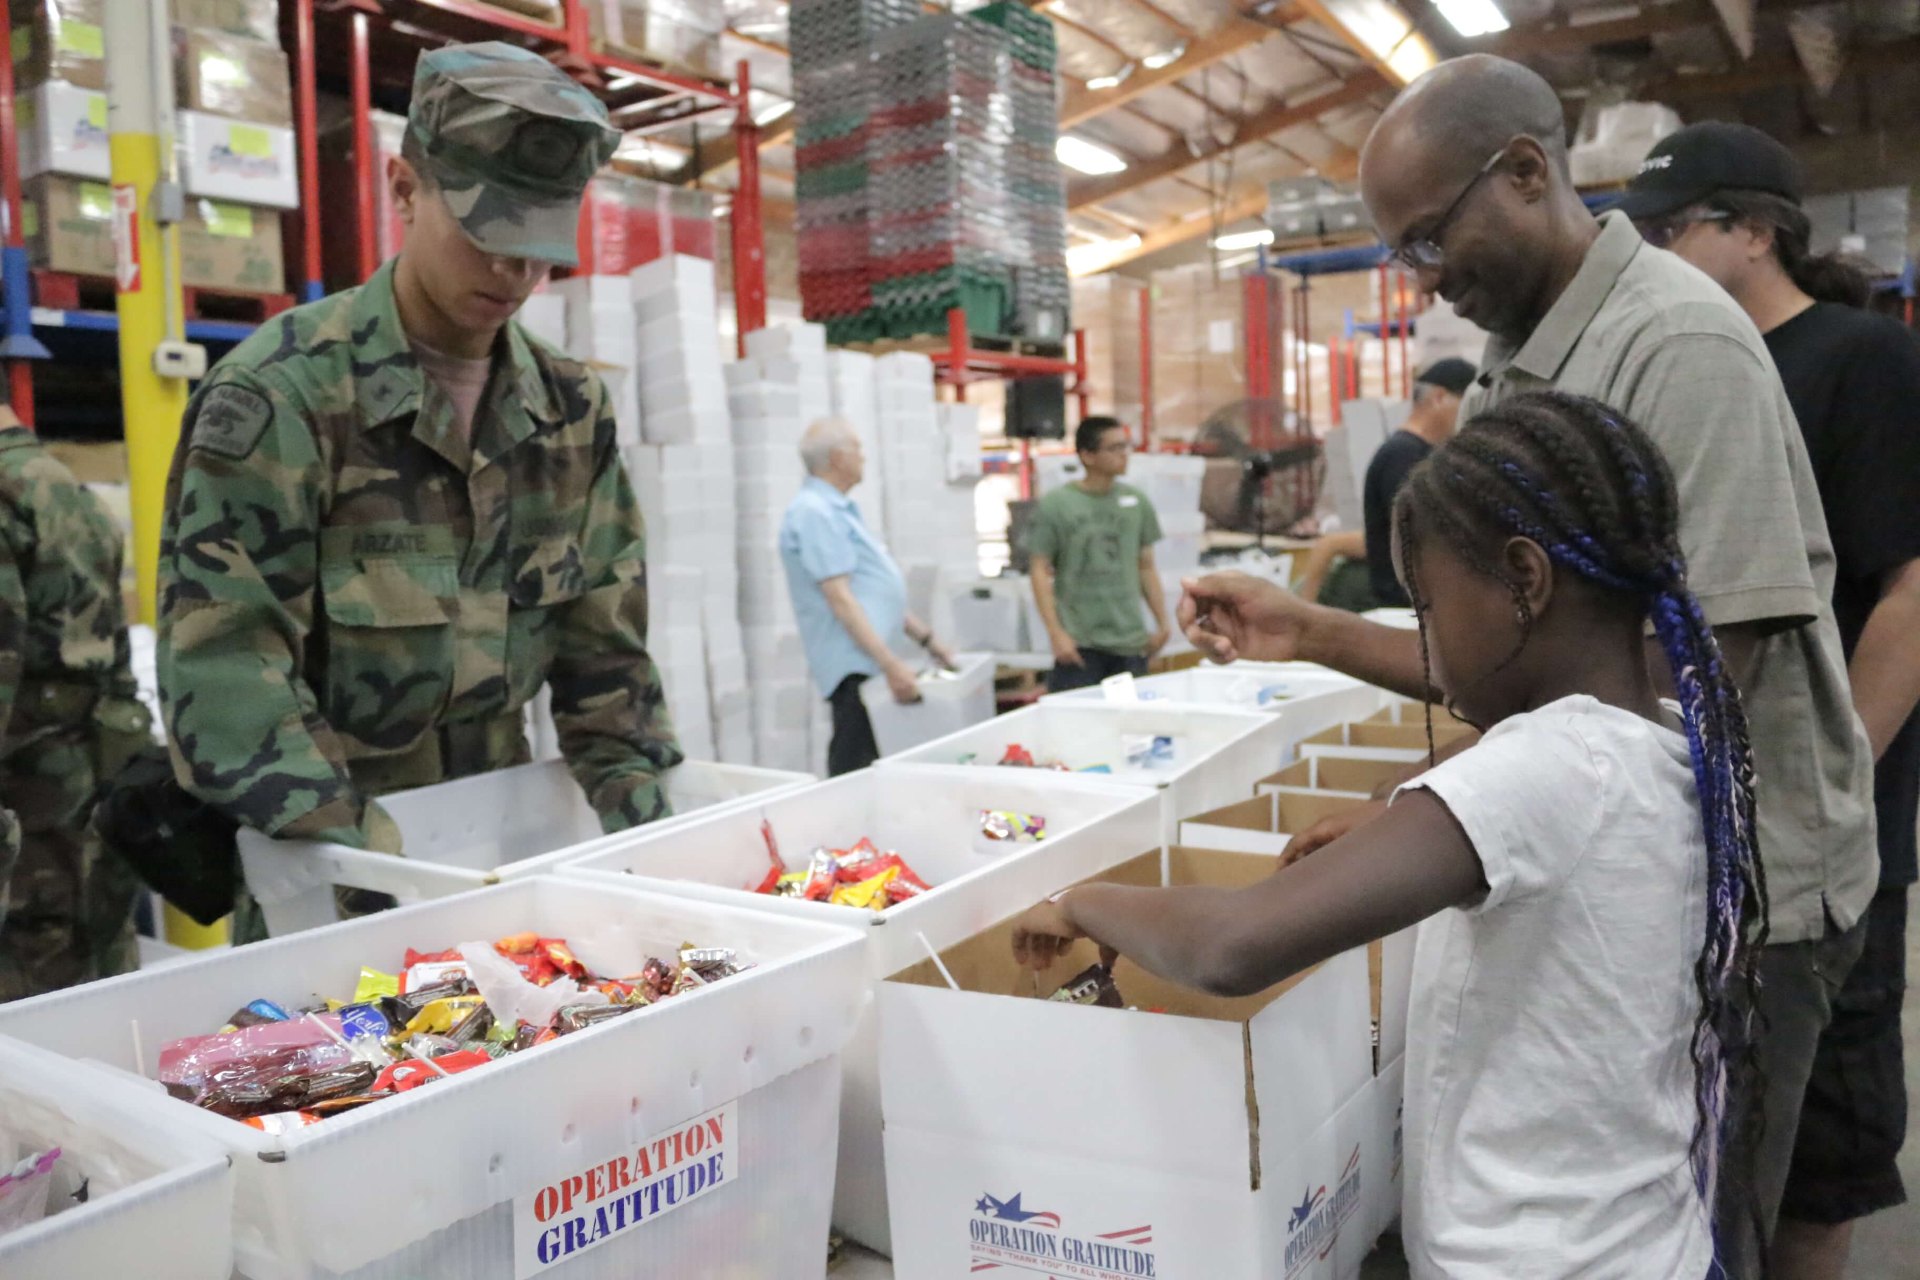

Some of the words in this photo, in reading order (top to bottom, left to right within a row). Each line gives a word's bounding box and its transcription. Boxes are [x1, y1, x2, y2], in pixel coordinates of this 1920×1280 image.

[351, 533, 427, 553] ARZATE
[341, 1008, 385, 1033] York
[533, 1113, 725, 1222] OPERATION
[537, 1152, 723, 1264] GRATITUDE
[969, 1218, 1057, 1257] OPERATION
[1062, 1237, 1156, 1277] GRATITUDE
[1066, 1264, 1078, 1272] TO
[1080, 1267, 1097, 1276] ALL
